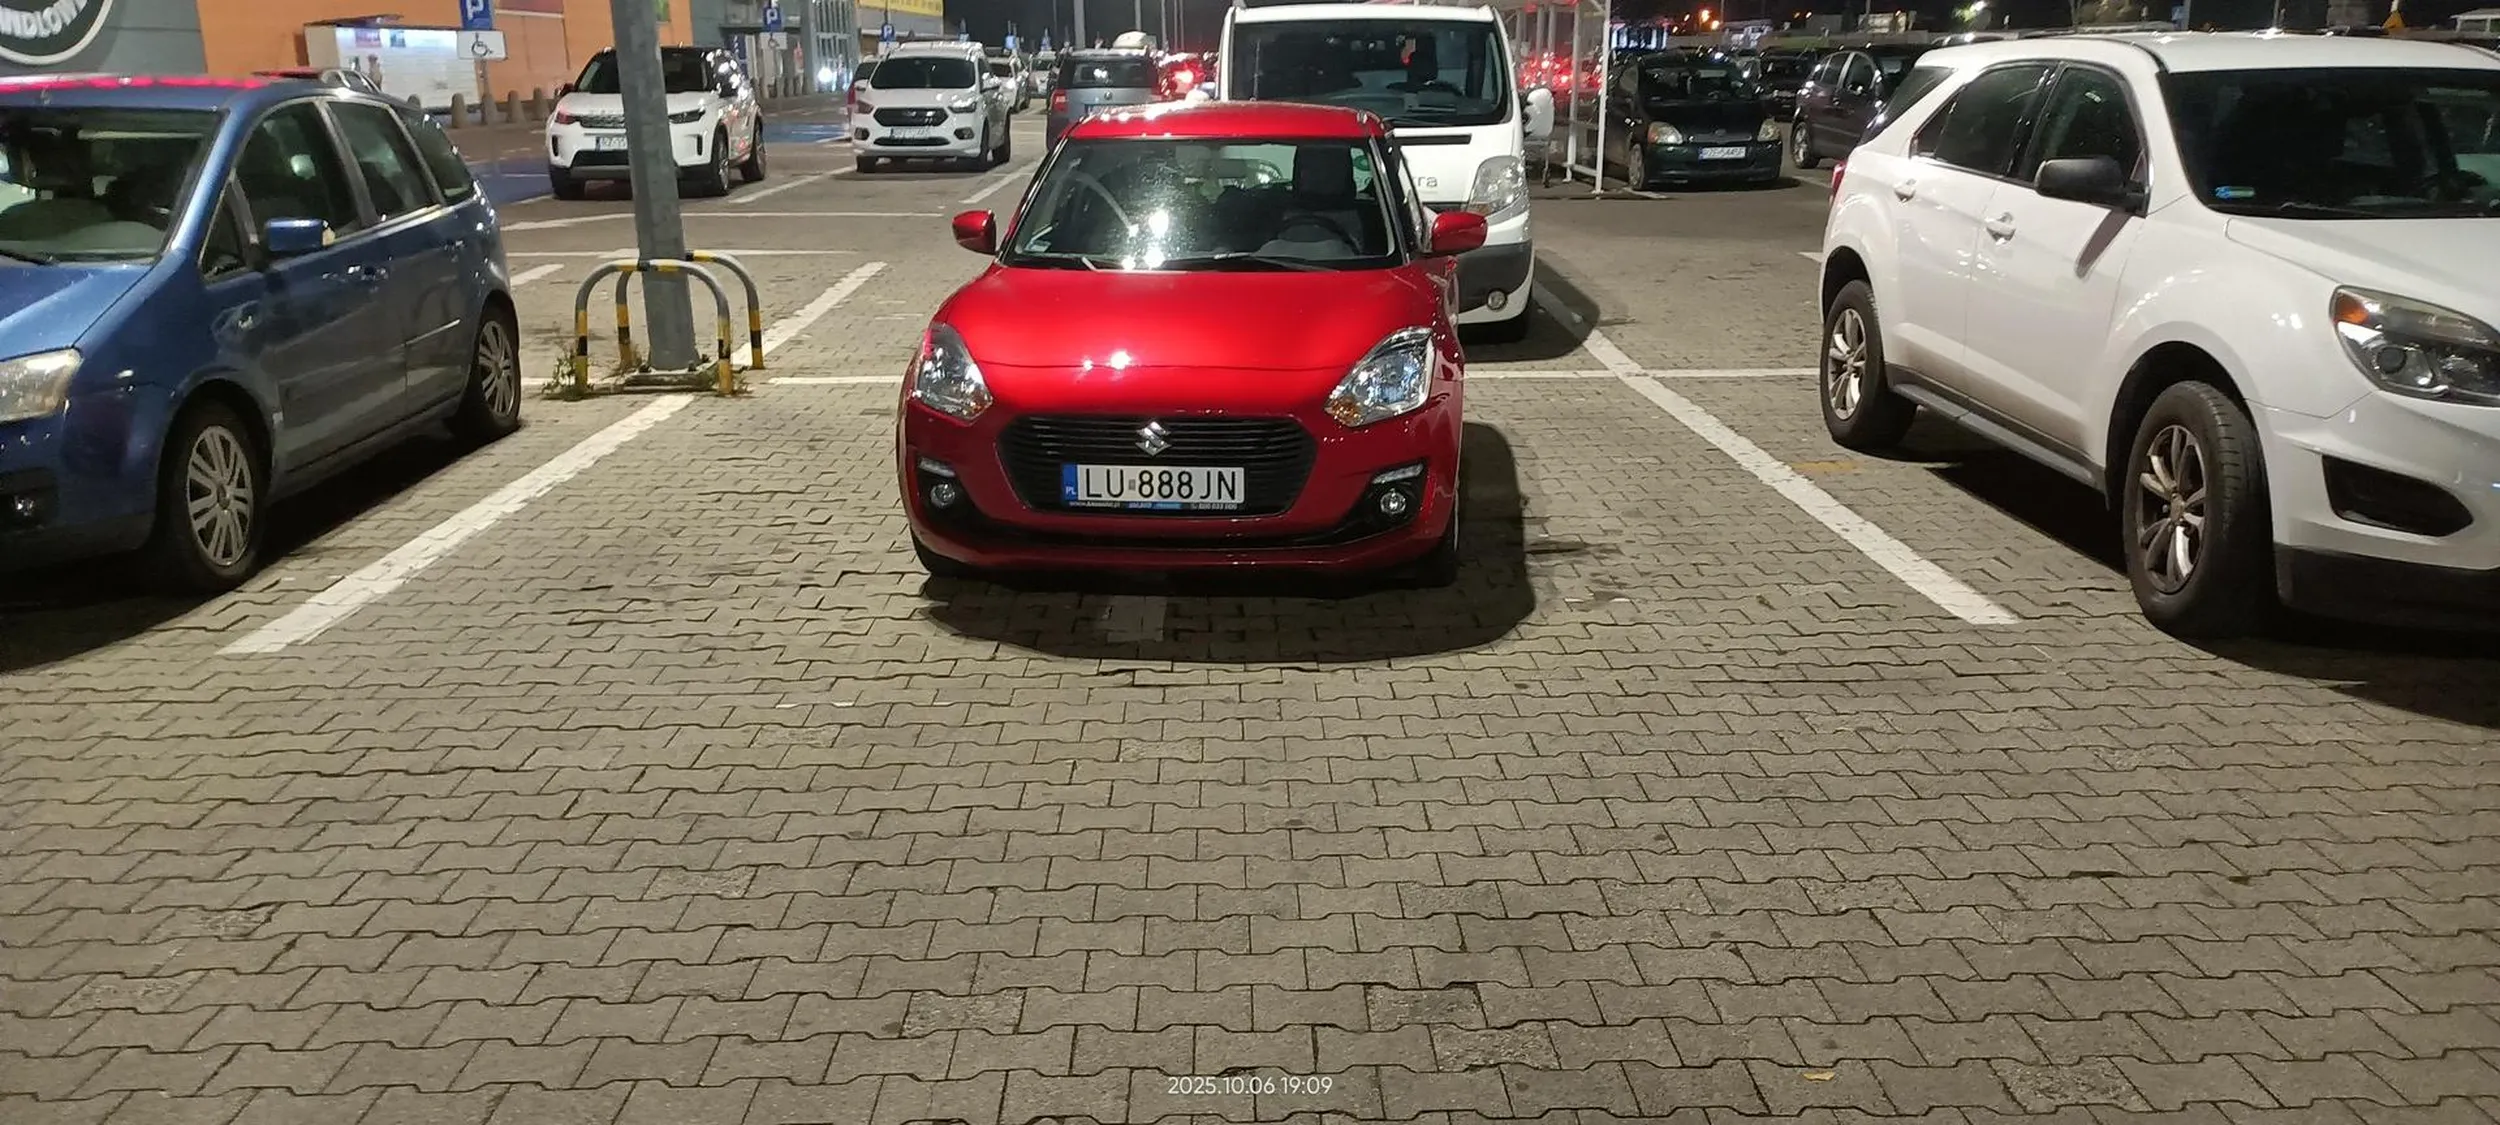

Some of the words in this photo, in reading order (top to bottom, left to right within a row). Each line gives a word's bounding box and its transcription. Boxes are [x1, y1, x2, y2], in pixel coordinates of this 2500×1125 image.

[0, 0, 88, 38] NDLOW
[466, 0, 485, 21] P
[766, 8, 778, 25] P
[883, 24, 893, 39] P
[1413, 176, 1438, 188] ra
[1065, 486, 1076, 495] PL
[1085, 468, 1124, 498] LU
[1138, 470, 1236, 500] 888JN
